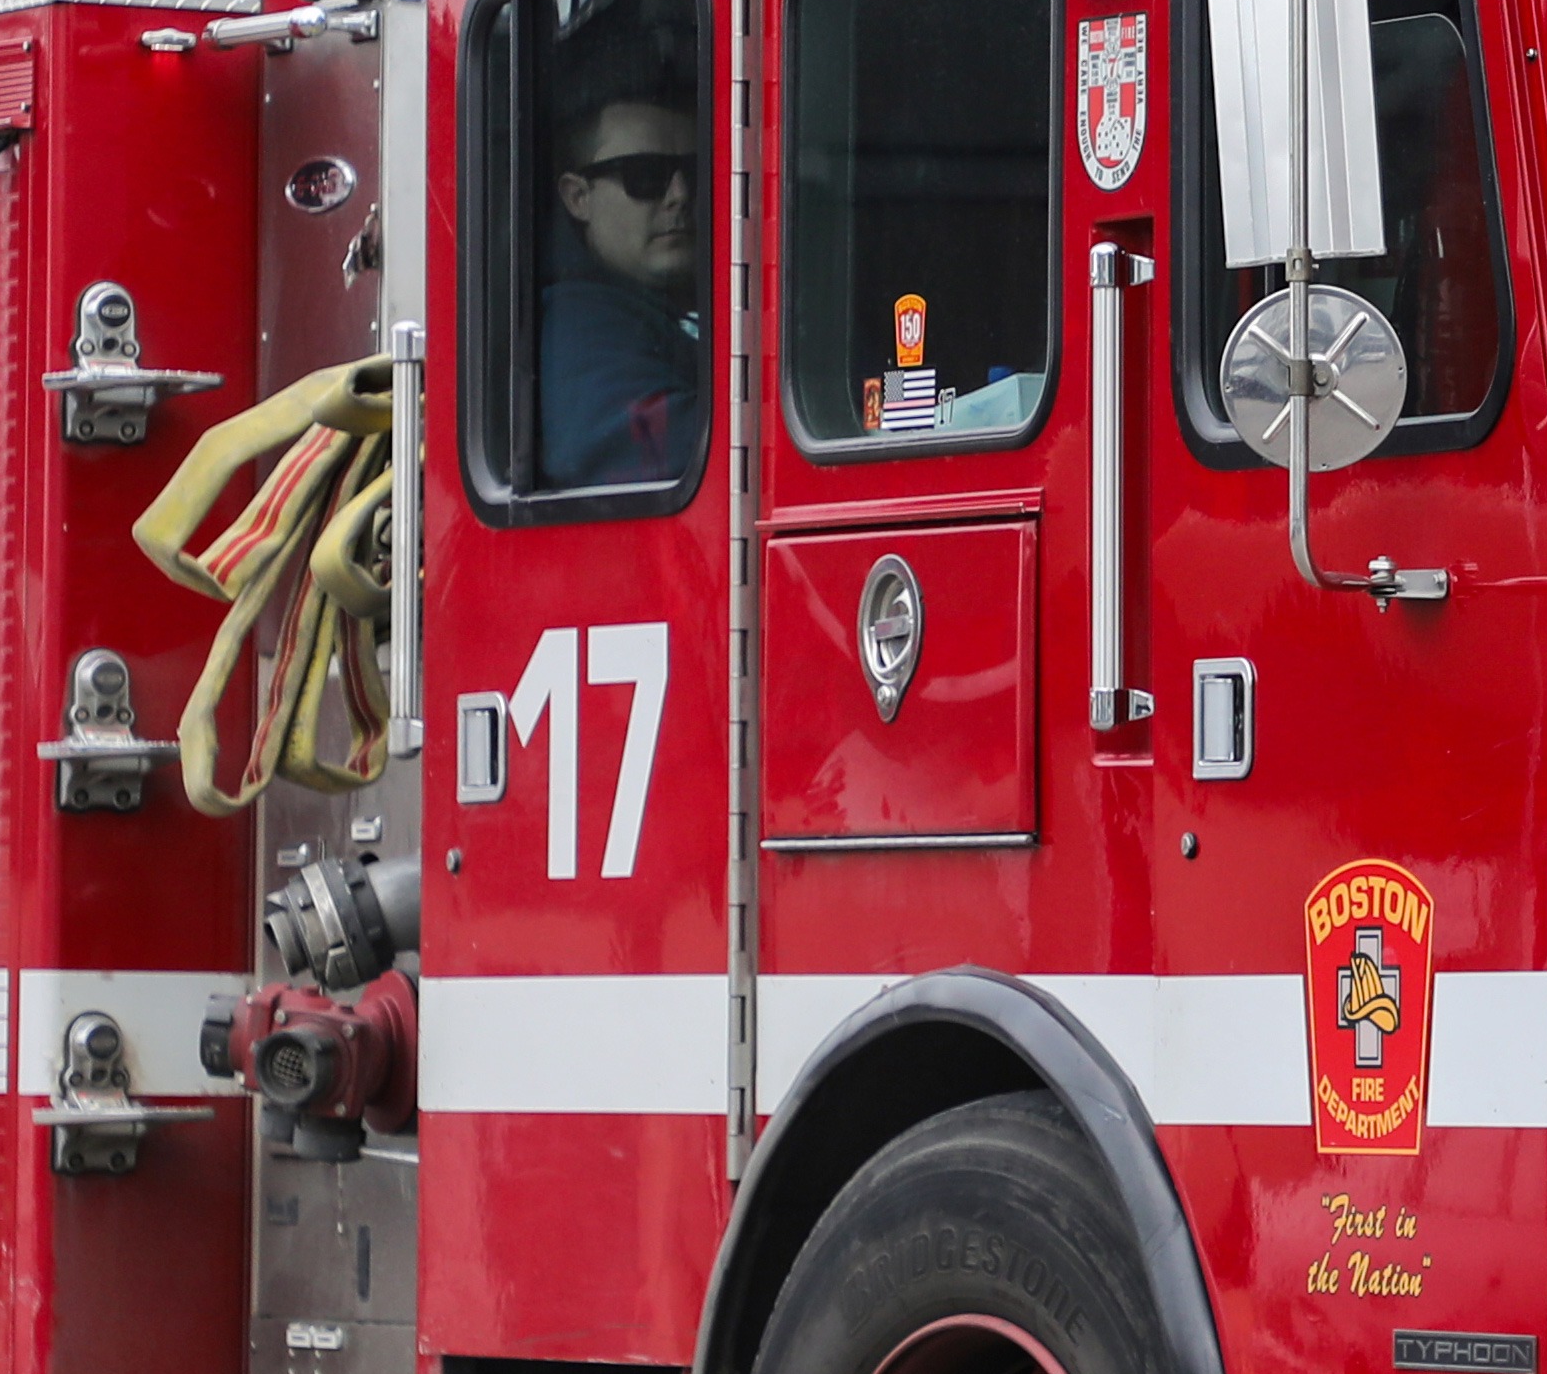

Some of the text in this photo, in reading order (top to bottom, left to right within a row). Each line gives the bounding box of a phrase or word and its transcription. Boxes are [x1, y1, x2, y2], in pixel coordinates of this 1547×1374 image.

[509, 622, 668, 880] 17
[1309, 875, 1429, 946] BOSTON
[1317, 1074, 1421, 1140] DEPARTMENT
[1351, 1077, 1385, 1103] FIRE
[1395, 1207, 1417, 1239] in
[1306, 1251, 1340, 1295] the
[1396, 1337, 1532, 1368] TYPHOON
